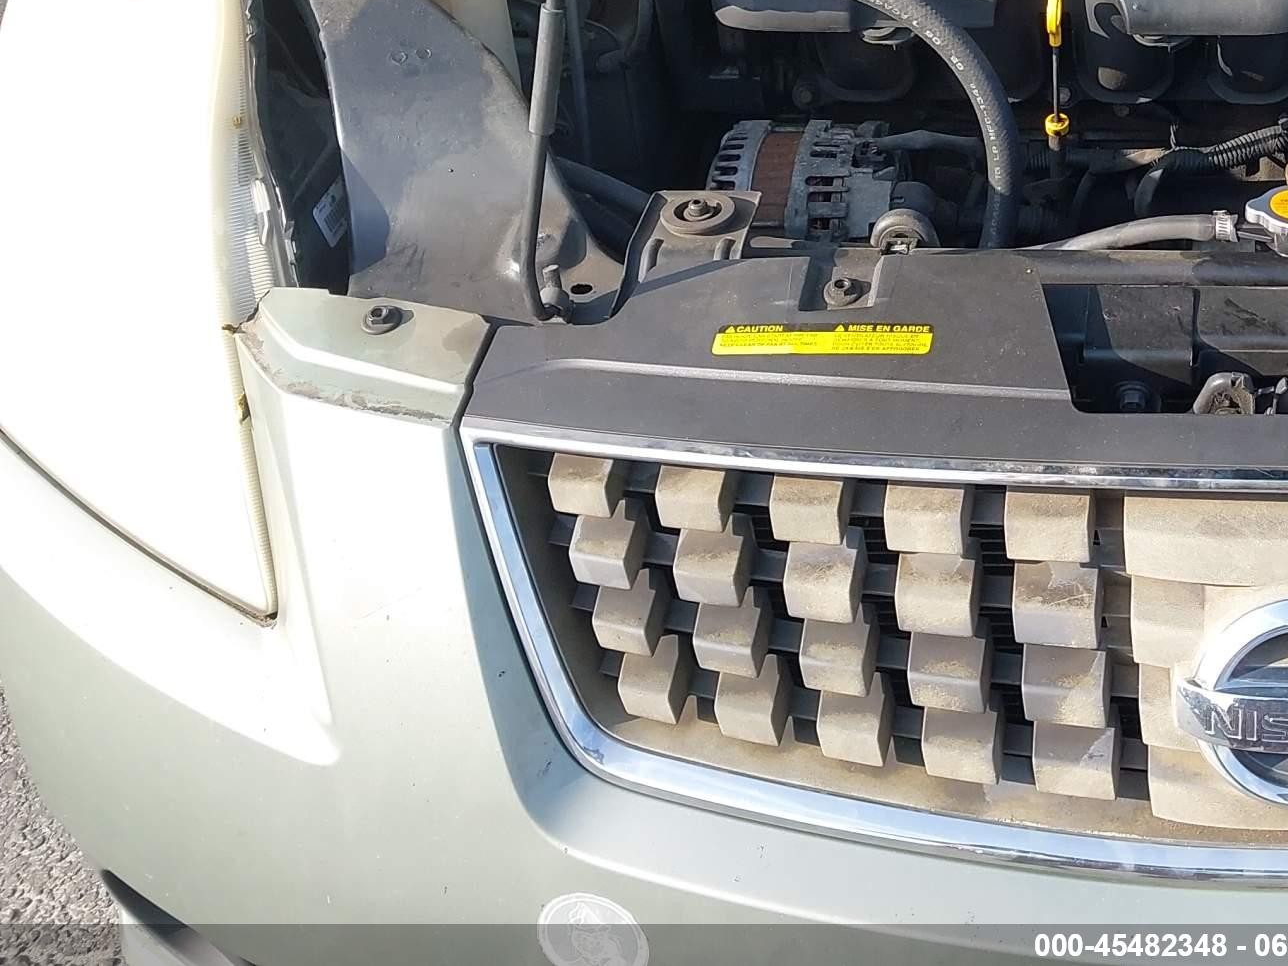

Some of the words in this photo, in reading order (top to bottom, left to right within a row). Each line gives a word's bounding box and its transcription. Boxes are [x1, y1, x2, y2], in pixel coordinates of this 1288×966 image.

[736, 325, 784, 333] CAUTION
[847, 324, 874, 332] MISE
[875, 324, 891, 333] EN
[892, 325, 931, 333] GARDE
